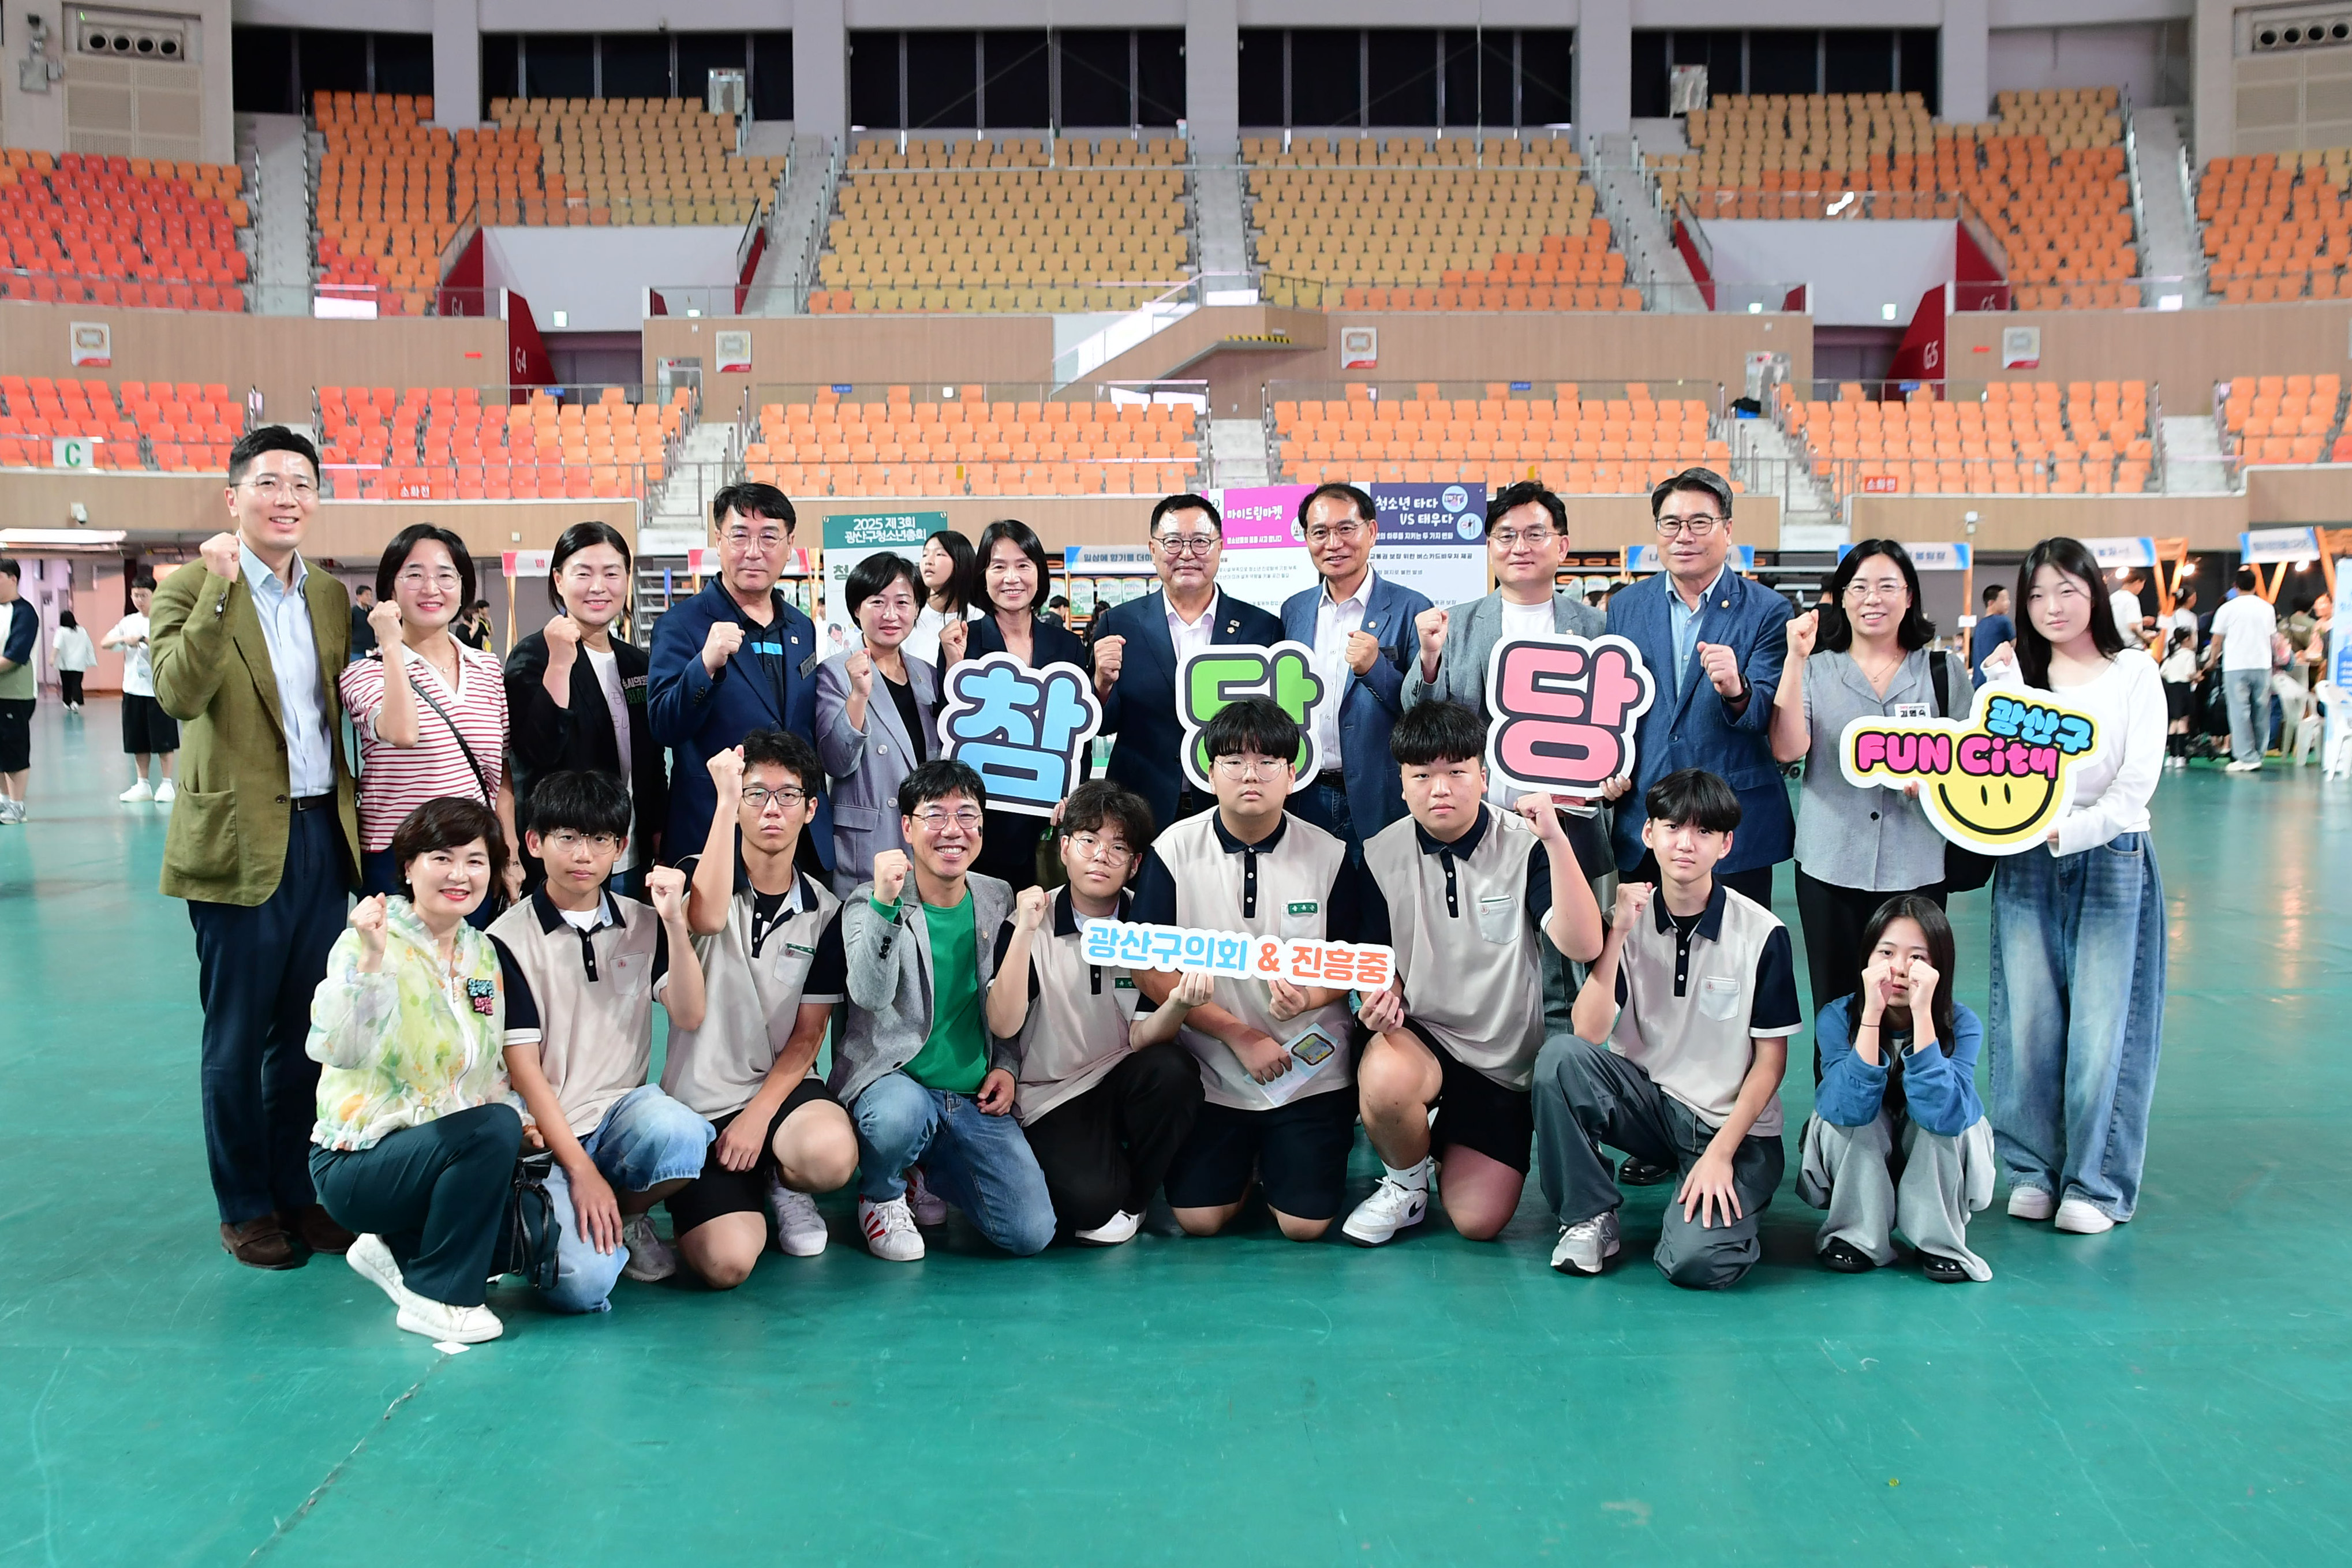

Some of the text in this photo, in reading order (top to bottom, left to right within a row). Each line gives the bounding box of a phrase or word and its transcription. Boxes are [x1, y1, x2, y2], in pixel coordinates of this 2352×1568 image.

[515, 346, 526, 374] G4
[65, 442, 81, 467] C
[400, 485, 430, 498] 소화전
[1375, 495, 1438, 511] 청소년 타다
[853, 518, 883, 530] 2025
[1227, 505, 1283, 521] 마이드림마켓
[1400, 512, 1454, 527] VS 태우다
[1084, 553, 1108, 562] 일상에
[1110, 553, 1134, 562] 향기를
[1500, 646, 1639, 783] 당
[1986, 697, 2093, 754] 광산구
[951, 665, 1089, 804] 참
[1857, 733, 2059, 779] FUN City
[1087, 926, 1388, 985] 광산구의회 & 진흥중
